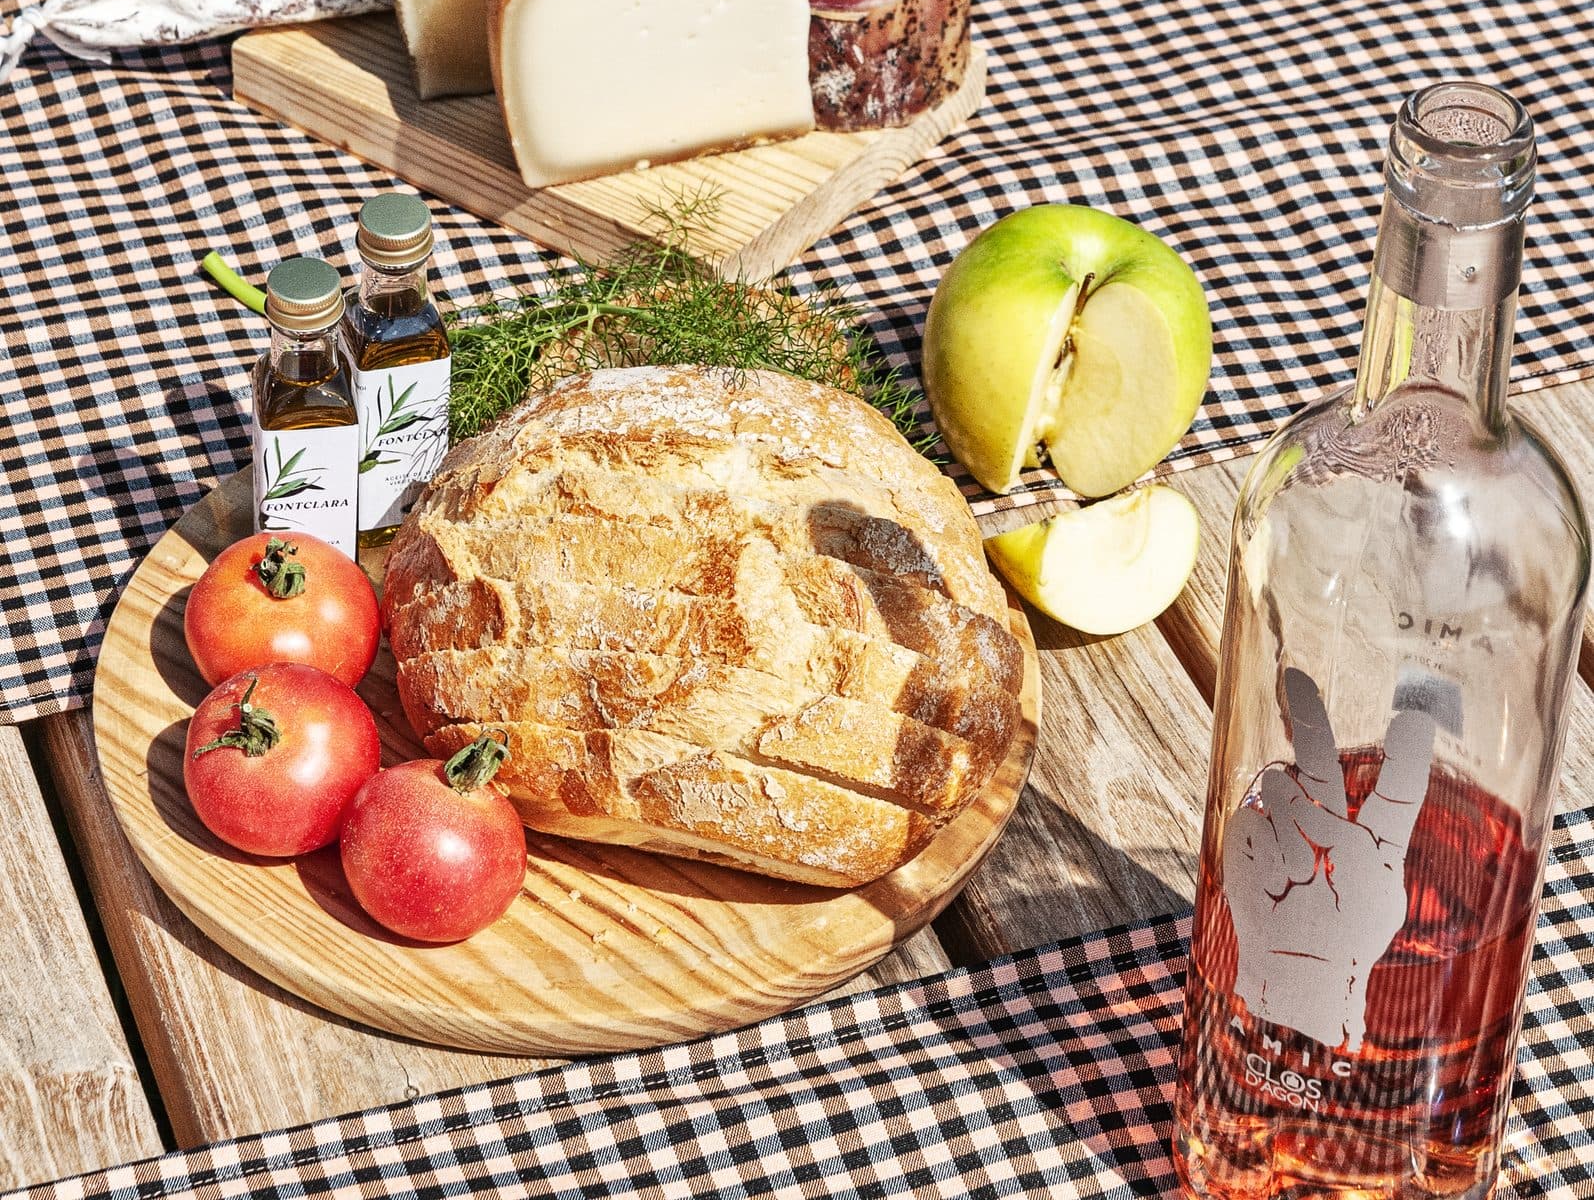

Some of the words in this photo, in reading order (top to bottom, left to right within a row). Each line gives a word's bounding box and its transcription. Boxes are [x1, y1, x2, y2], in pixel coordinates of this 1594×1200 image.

[265, 498, 350, 513] FONTCLARA
[1230, 1015, 1351, 1077] AMIC
[1245, 1069, 1320, 1112] D'AGON
[1246, 1053, 1322, 1100] CLOS
